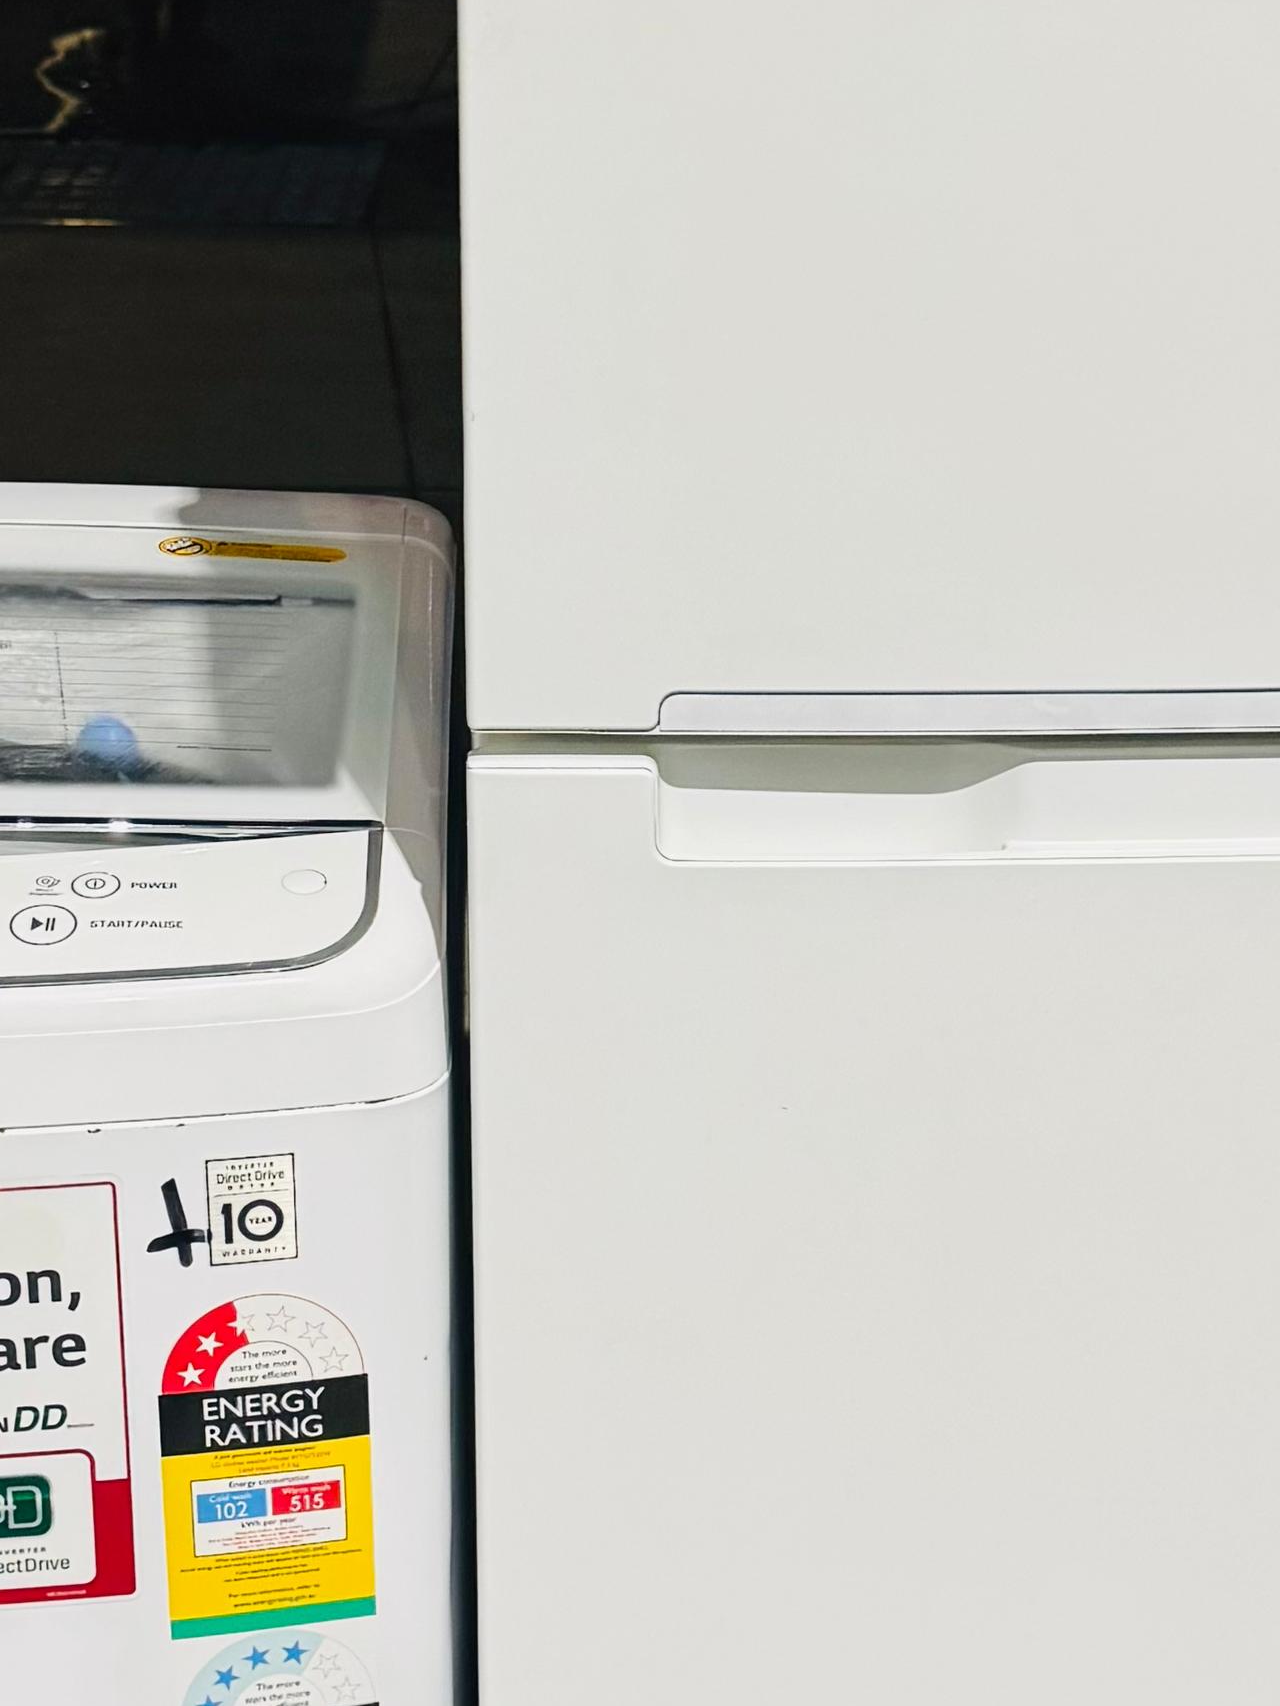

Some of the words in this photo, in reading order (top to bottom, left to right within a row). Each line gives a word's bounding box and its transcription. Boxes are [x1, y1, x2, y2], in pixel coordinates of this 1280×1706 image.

[131, 881, 178, 890] POWER
[216, 1171, 252, 1185] Direct
[254, 1169, 285, 1181] Drive
[220, 1198, 285, 1245] 10
[242, 1350, 259, 1360] The
[262, 1348, 287, 1358] more
[254, 1359, 270, 1370] the
[272, 1359, 298, 1369] more
[228, 1373, 259, 1384] energy
[202, 1386, 326, 1421] ENERGY
[204, 1414, 324, 1448] RATING
[215, 1500, 249, 1520] 102
[289, 1492, 325, 1513] 515
